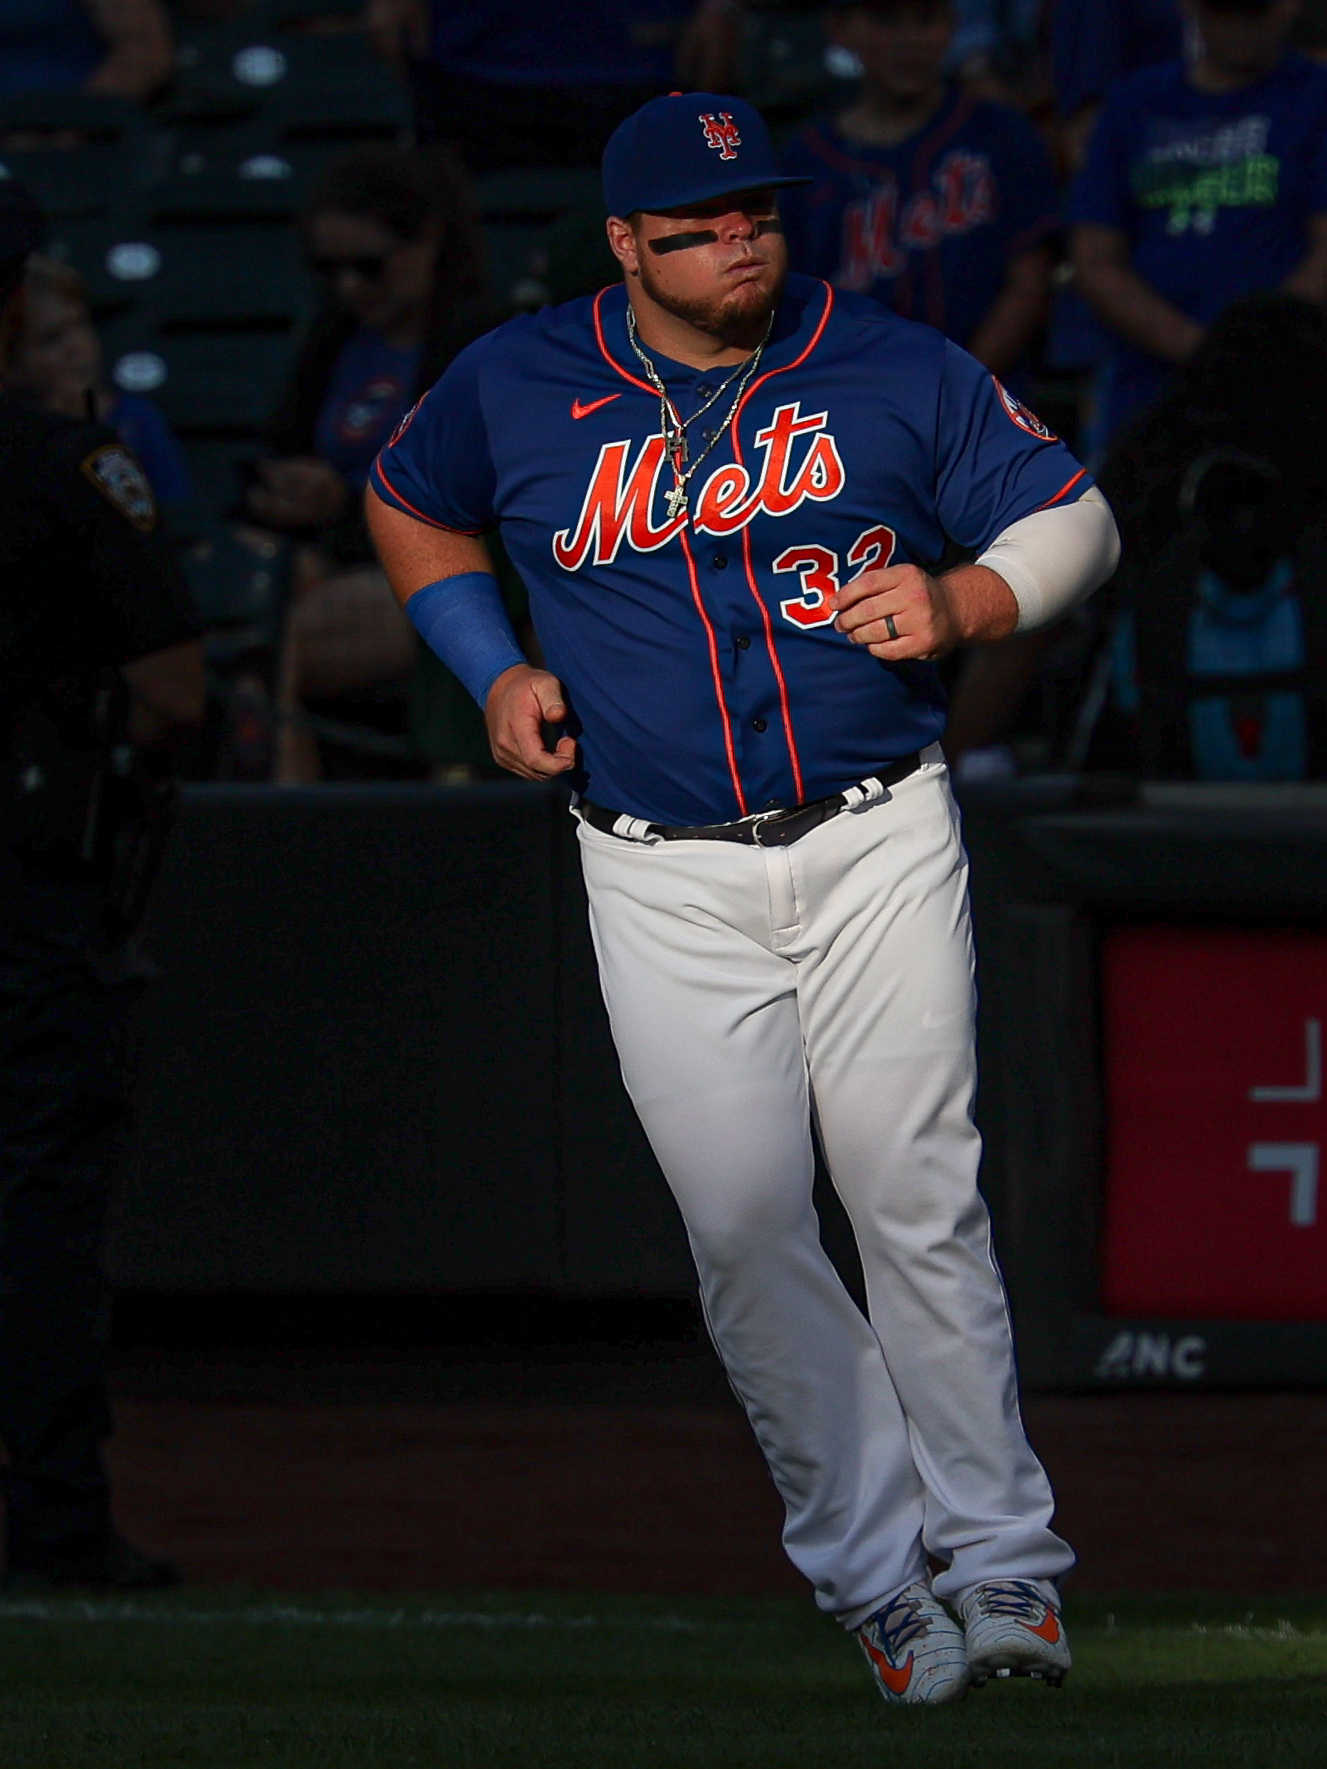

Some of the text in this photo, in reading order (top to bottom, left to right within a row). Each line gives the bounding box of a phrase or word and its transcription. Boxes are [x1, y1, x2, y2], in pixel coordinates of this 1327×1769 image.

[698, 111, 742, 161] NY
[830, 150, 1000, 293] Mets
[552, 400, 846, 573] Mets
[771, 524, 896, 630] 32
[1094, 1330, 1207, 1381] ANC
